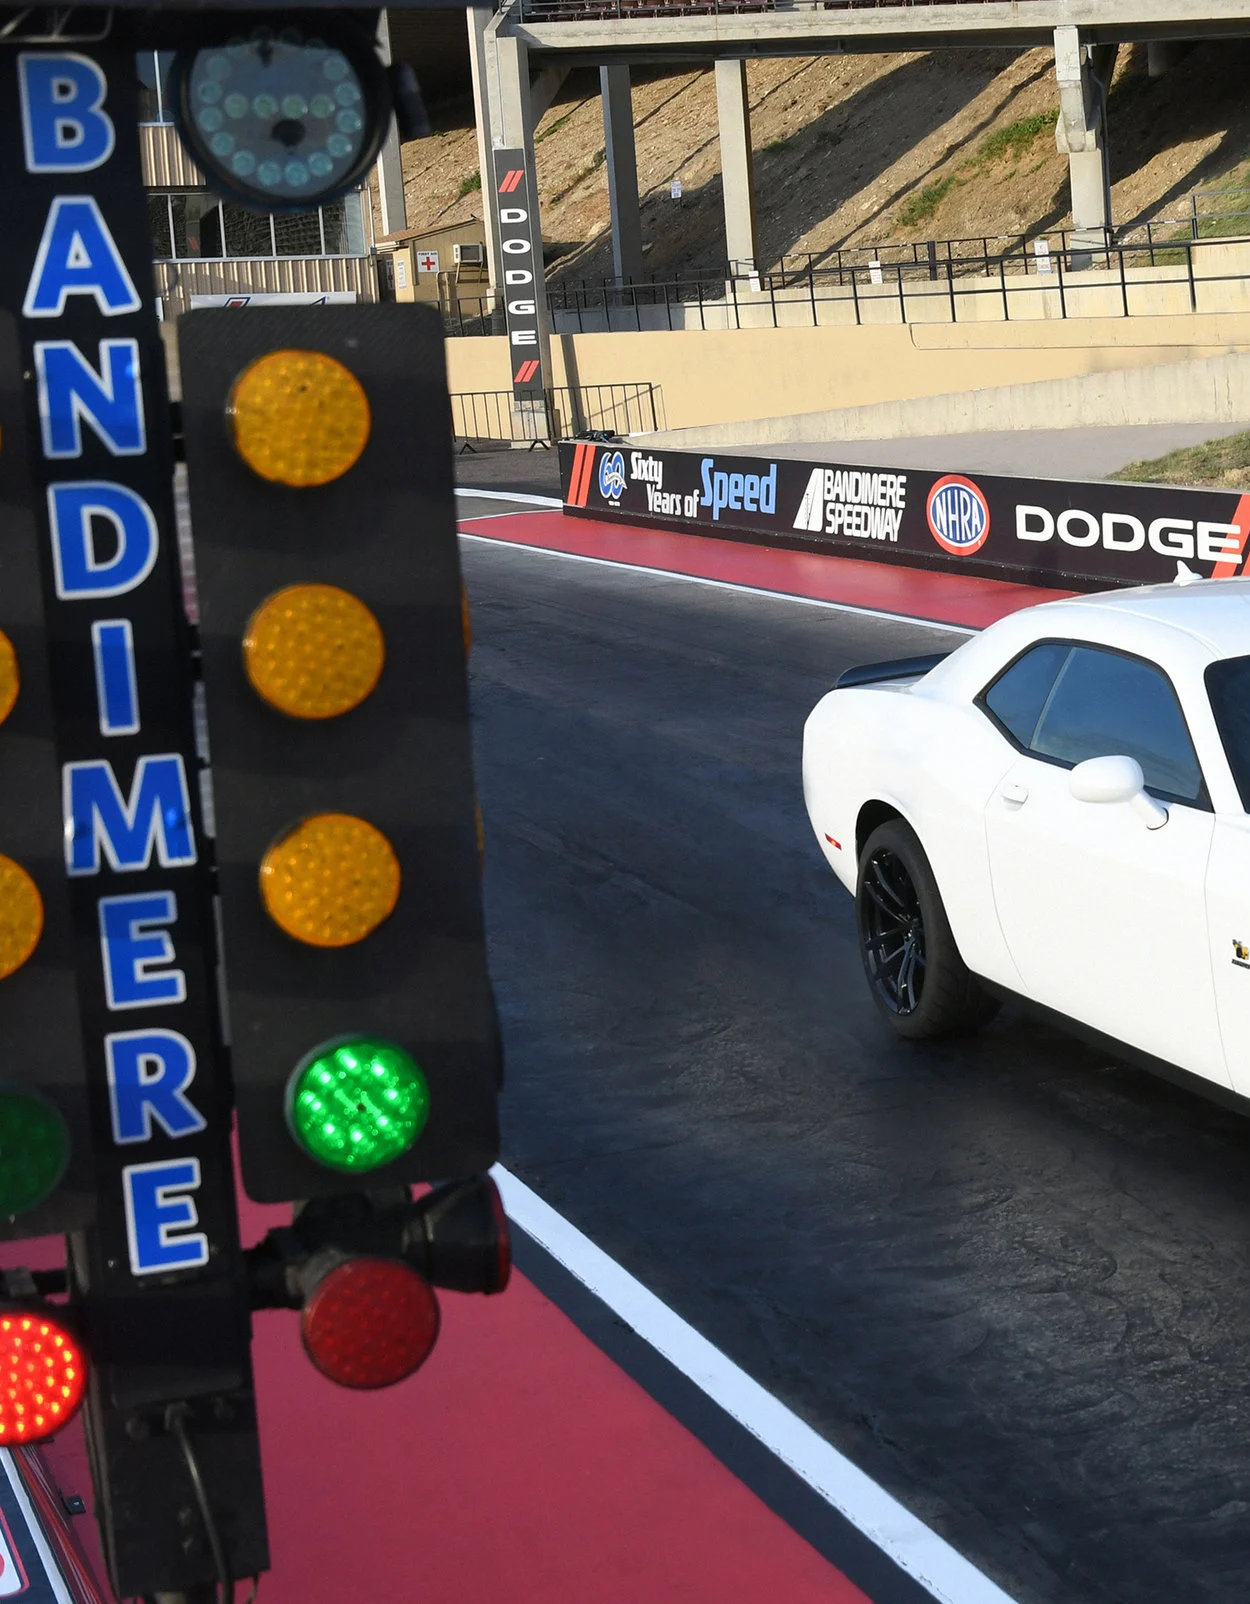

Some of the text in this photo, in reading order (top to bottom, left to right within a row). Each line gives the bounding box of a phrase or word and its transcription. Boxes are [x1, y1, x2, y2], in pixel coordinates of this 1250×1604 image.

[500, 208, 537, 345] DODGE
[630, 451, 663, 490] Sixty
[700, 458, 777, 520] Speed
[824, 469, 906, 509] BANDIMERE
[647, 488, 699, 518] Years of
[825, 507, 903, 543] SPEEDWAY
[935, 487, 982, 540] NHRA
[1015, 504, 1243, 564] DODGE
[18, 52, 208, 1275] BANDIMERE
